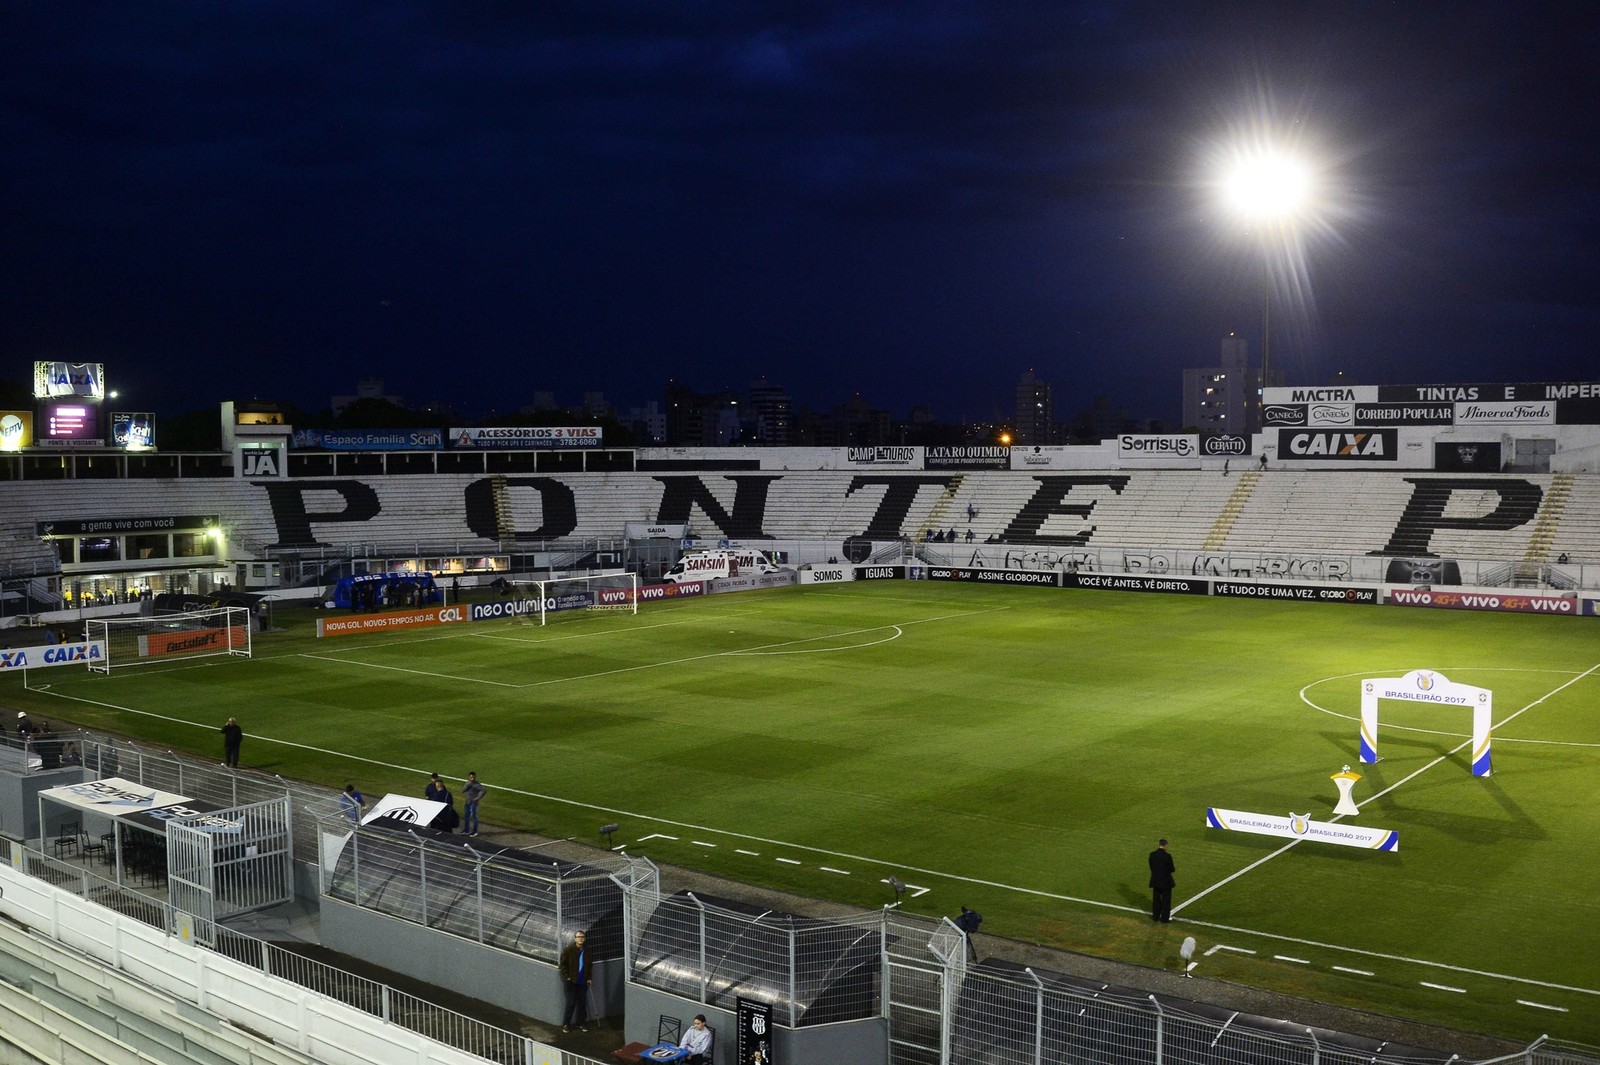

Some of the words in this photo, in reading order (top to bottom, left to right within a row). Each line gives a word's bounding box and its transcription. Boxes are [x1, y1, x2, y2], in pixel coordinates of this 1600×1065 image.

[1291, 389, 1356, 402] MACTRA
[1416, 387, 1479, 401] TINTAS
[1504, 386, 1516, 399] E
[1356, 408, 1401, 420] CORREIO
[1402, 407, 1452, 420] POPULAR
[1459, 405, 1514, 419] Minerva
[1514, 405, 1551, 418] Foods
[4, 419, 23, 438] EPTV
[477, 427, 552, 438] ACESSÓRIOS
[554, 429, 563, 437] 3
[567, 428, 597, 437] VIAS
[324, 434, 364, 446] Espaço
[366, 433, 405, 445] Família
[410, 433, 442, 446] SCHIN
[1121, 436, 1188, 453] Sorrisus
[1209, 441, 1242, 451] CERATTI
[1290, 433, 1384, 455] CAIXA
[848, 447, 874, 460] CAMP
[244, 451, 278, 475] JÁ
[250, 475, 1130, 552] PONTE
[81, 523, 86, 531] a
[88, 521, 112, 532] gente
[114, 520, 132, 529] vive
[134, 520, 152, 528] com
[153, 517, 175, 527] você
[686, 558, 725, 571] SANSIM
[736, 555, 754, 568] SIM
[813, 569, 842, 582] SOMOS
[865, 566, 894, 579] IGUAIS
[931, 569, 951, 578] GLOBO
[977, 571, 1004, 580] ASSINE
[1005, 573, 1053, 583] GLOBOPLAY.
[1078, 574, 1100, 586] VOCÊ
[1101, 575, 1113, 587] VÊ
[1113, 578, 1143, 589] ANTES.
[1143, 577, 1155, 589] VÊ
[1156, 580, 1190, 591] DIRETO.
[1216, 581, 1228, 594] VÊ
[1230, 584, 1256, 595] TUDO
[1258, 586, 1270, 596] DE
[1271, 587, 1294, 597] UMA
[1295, 588, 1316, 598] VEZ.
[602, 591, 625, 602] VIVO
[642, 587, 664, 599] VIVO
[680, 583, 701, 594] VIVO
[1320, 590, 1346, 599] GLOBO
[1356, 591, 1373, 600] PLAY
[1394, 592, 1432, 604] VIVO
[1433, 594, 1459, 605] 4G+
[1461, 595, 1500, 608] VIVO
[1501, 597, 1528, 609] 4G+
[1530, 599, 1571, 611] VIVO
[438, 608, 463, 622] GOL
[474, 603, 502, 619] neo
[326, 622, 346, 631] NOVA
[363, 618, 387, 628] NOVOS
[388, 616, 413, 625] TEMPOS
[414, 614, 424, 623] NO
[43, 645, 101, 664] CAIXA
[1385, 690, 1442, 702] BRASILEIRÃO
[1444, 696, 1466, 704] 2017
[1229, 817, 1272, 829] BRASILEIRÃO
[1309, 828, 1353, 840] BRASILEIRÃO
